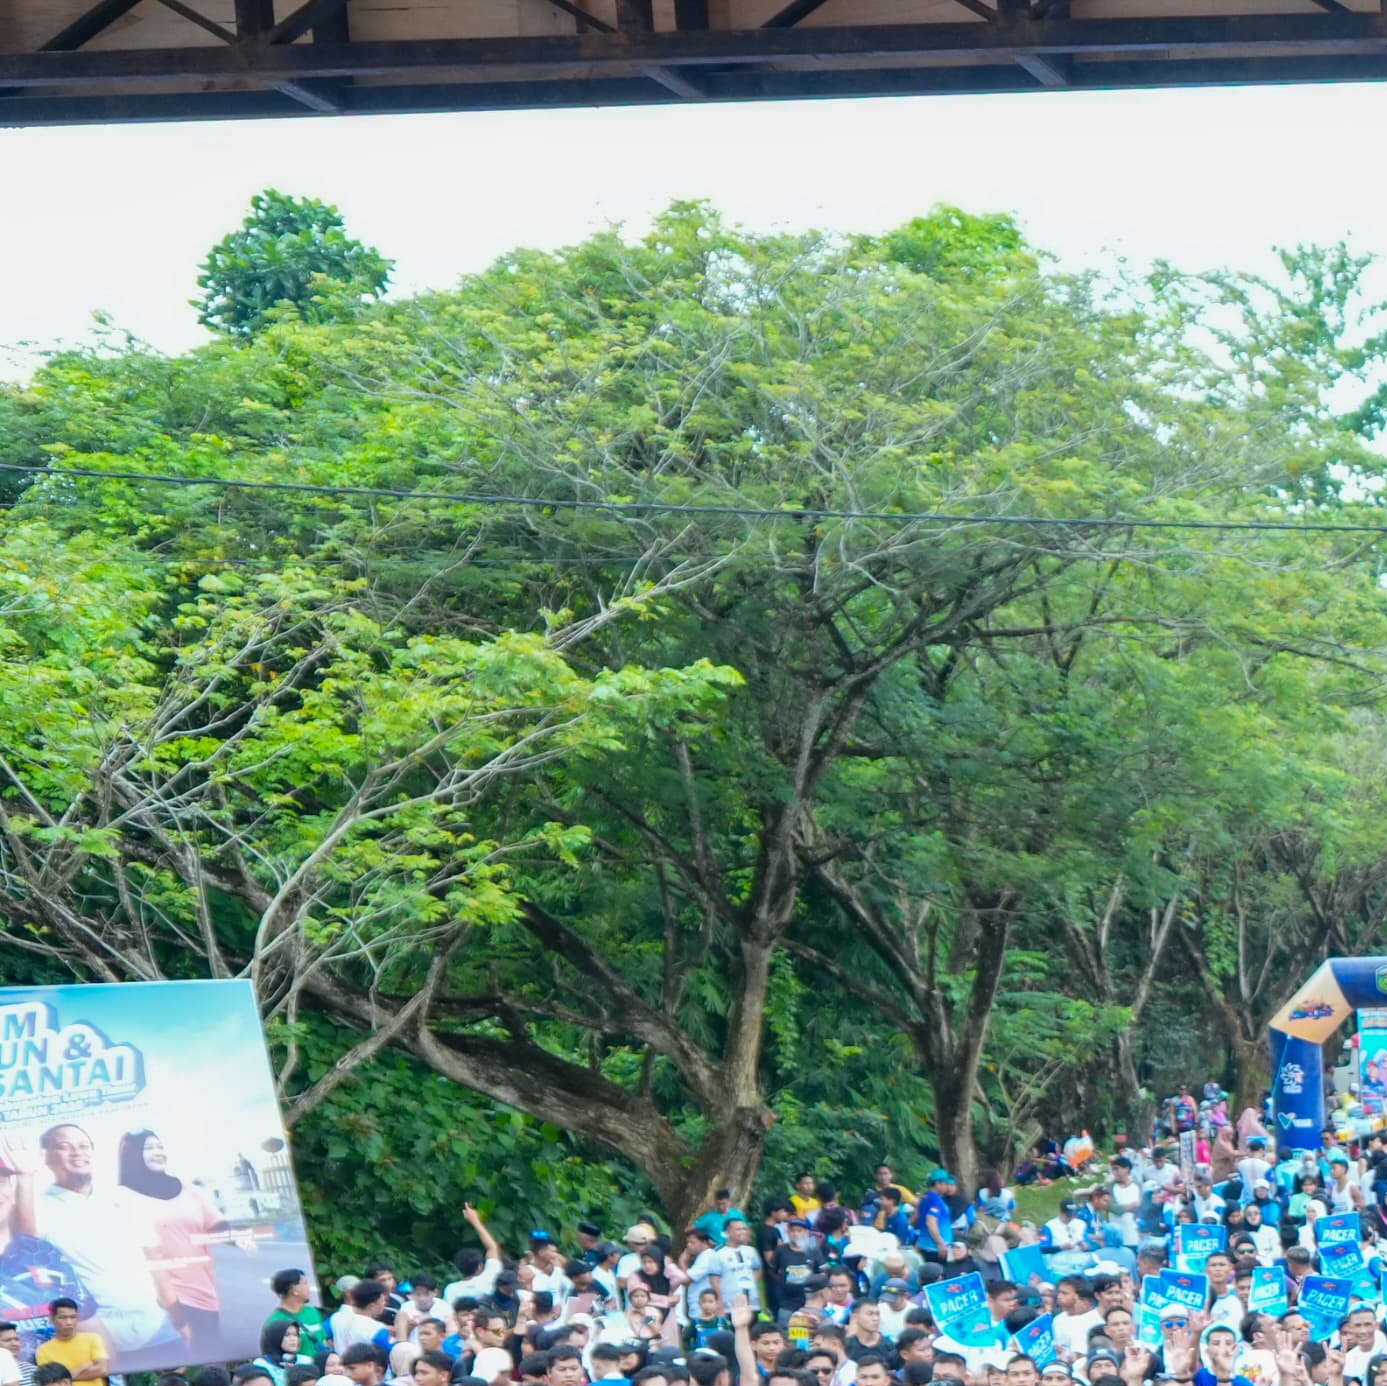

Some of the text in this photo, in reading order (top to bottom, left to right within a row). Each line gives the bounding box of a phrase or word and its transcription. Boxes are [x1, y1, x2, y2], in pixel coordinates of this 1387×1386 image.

[63, 1032, 92, 1060] &
[0, 1055, 124, 1097] ANTAI
[1321, 1228, 1356, 1241] PACER
[940, 1289, 978, 1315] PACER
[1166, 1285, 1204, 1305] PACER
[1306, 1289, 1346, 1311] PACER
